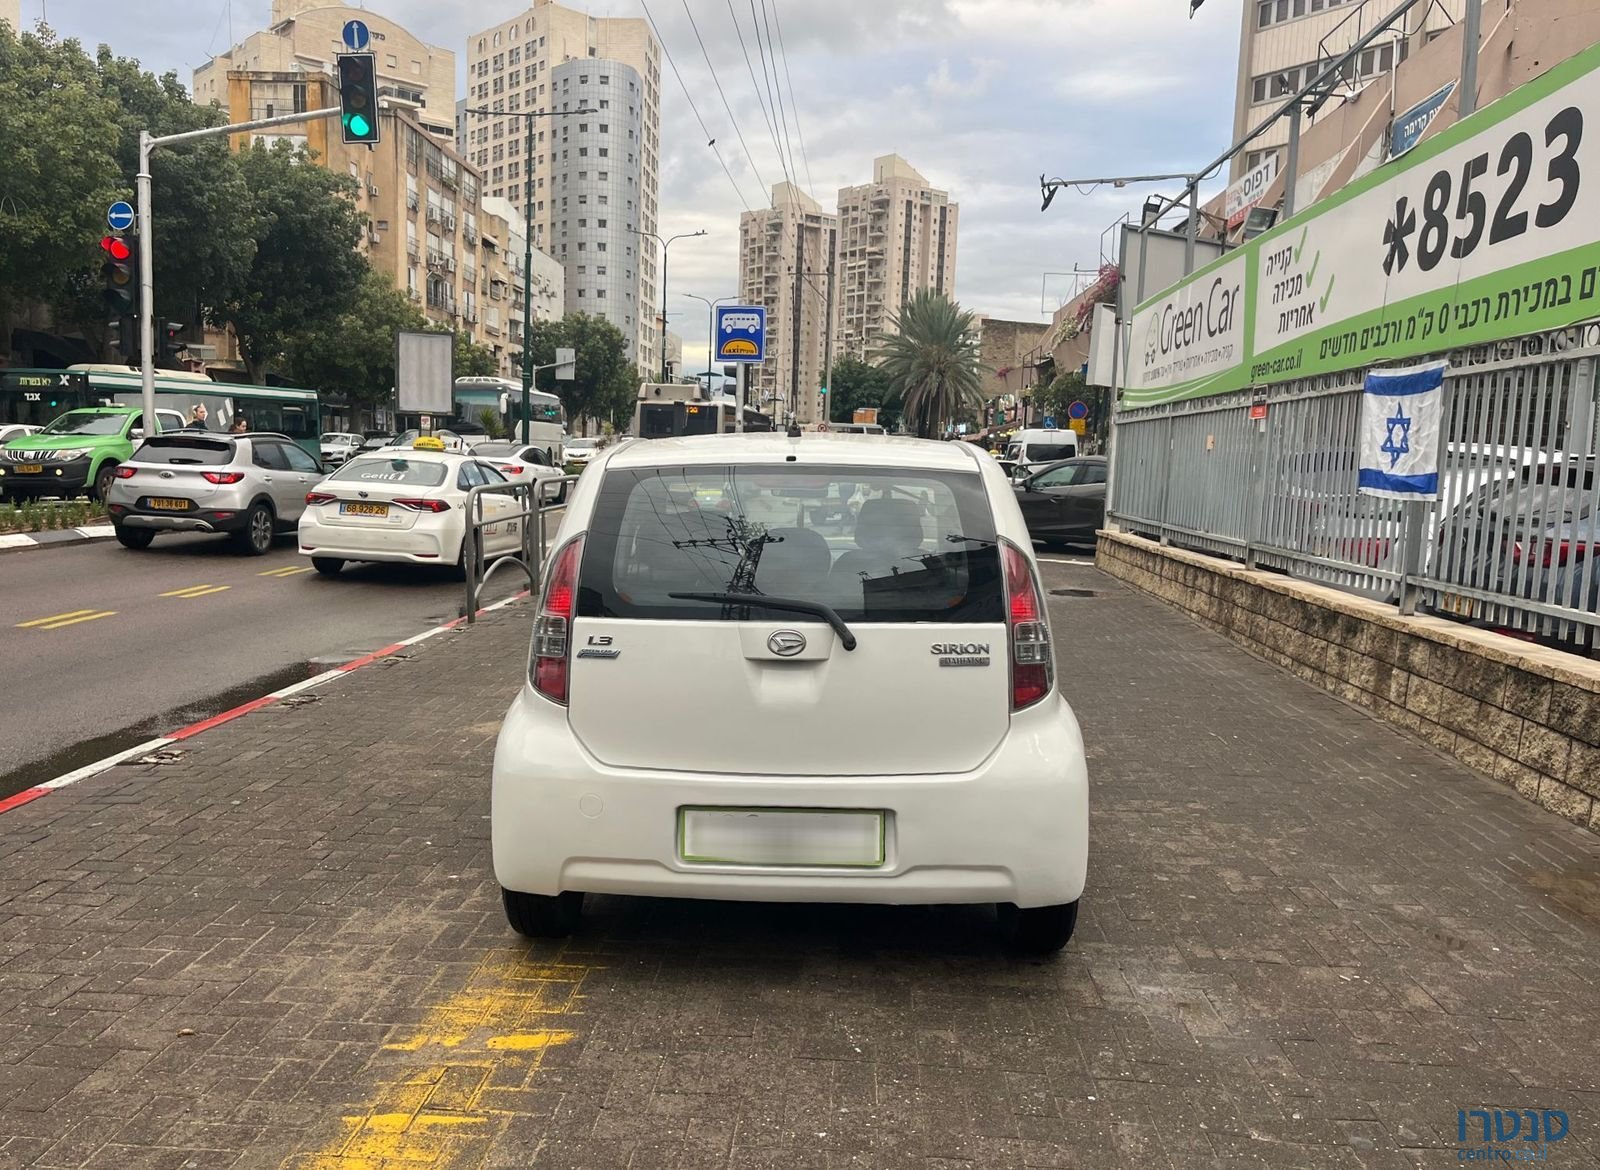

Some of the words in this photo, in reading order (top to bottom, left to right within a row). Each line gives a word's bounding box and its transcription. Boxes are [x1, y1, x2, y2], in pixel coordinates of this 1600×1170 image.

[1404, 114, 1427, 138] קדימה
[1243, 163, 1270, 197] דפוס
[1266, 245, 1293, 277] קנייה
[1272, 273, 1303, 305] מכירה
[1493, 274, 1572, 321] במכירת
[1160, 303, 1203, 355] Green
[1207, 277, 1240, 338] Car
[1277, 301, 1316, 334] אחריות
[1454, 296, 1491, 330] רכבי
[1319, 331, 1358, 360] חדשים
[1360, 319, 1402, 351] ורכבים
[1250, 348, 1303, 383] green-car.co.il
[930, 643, 990, 656] SIRION
